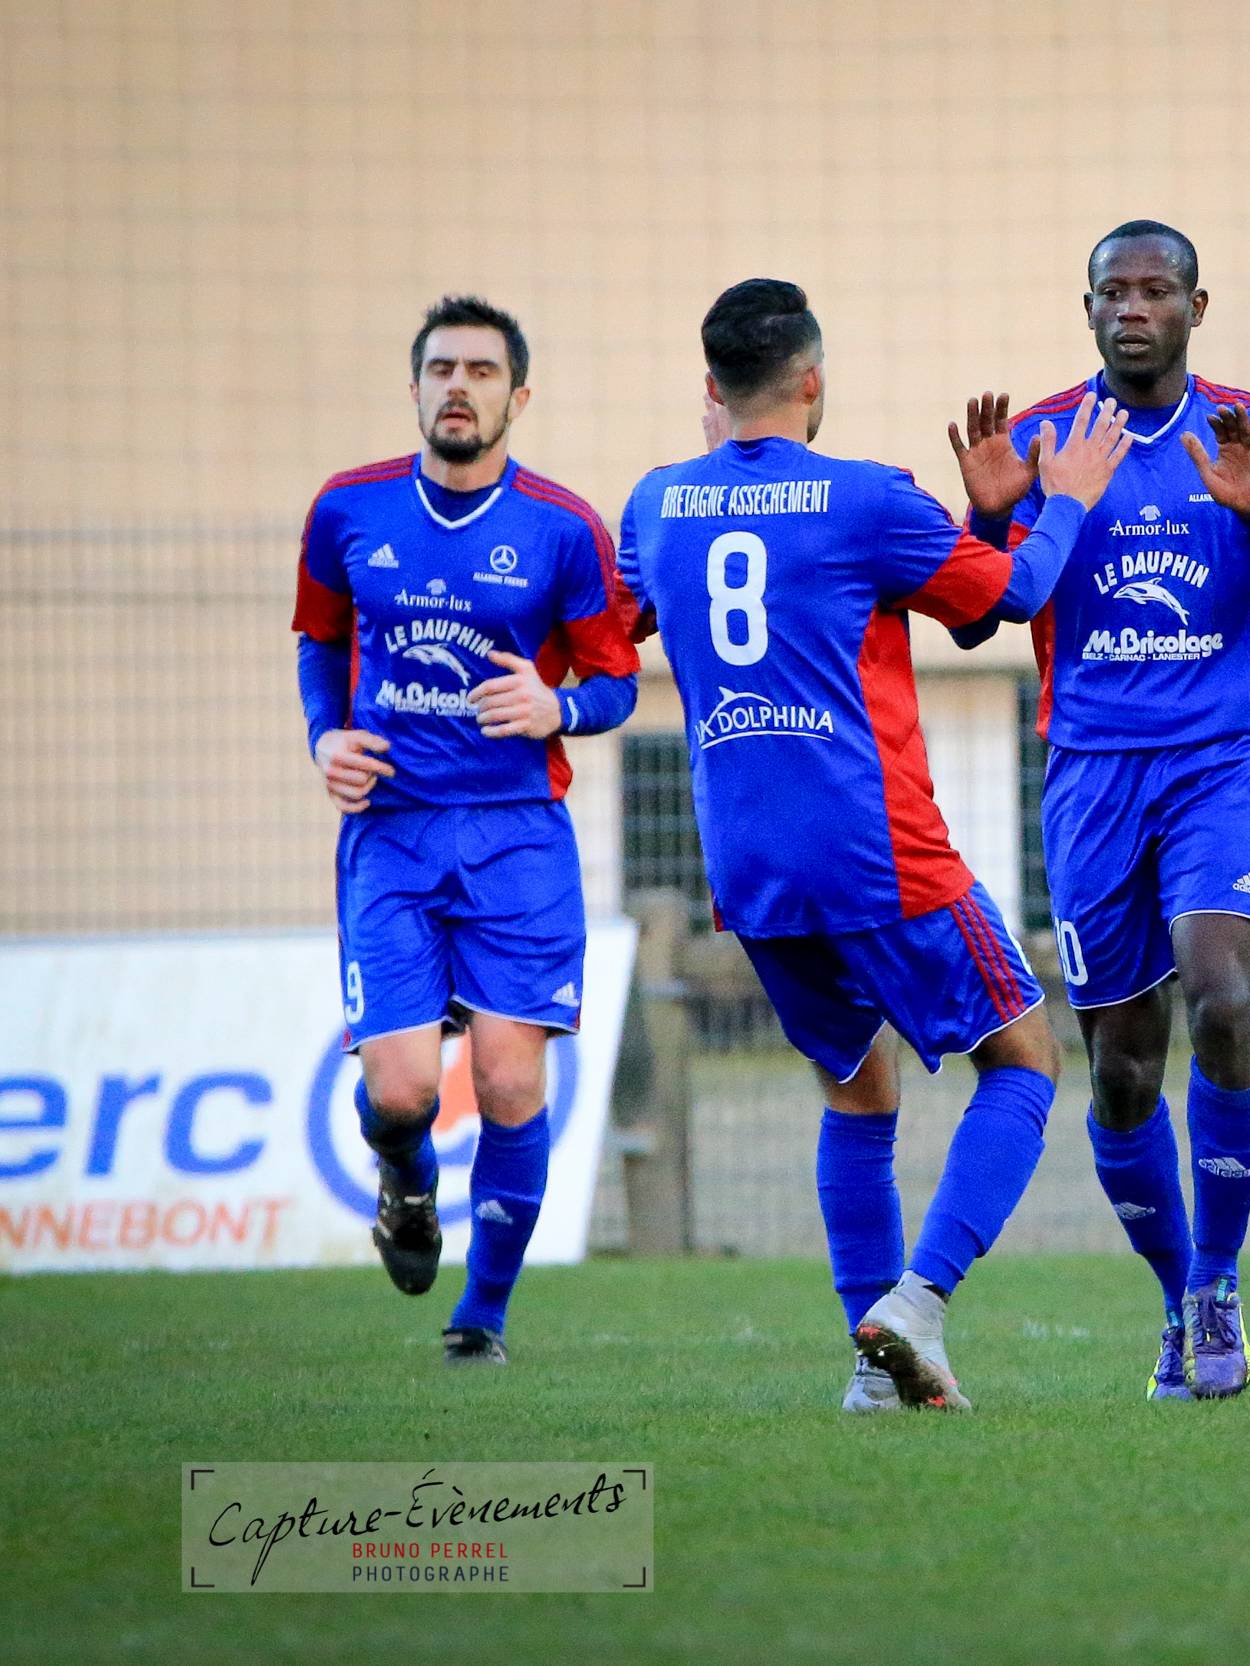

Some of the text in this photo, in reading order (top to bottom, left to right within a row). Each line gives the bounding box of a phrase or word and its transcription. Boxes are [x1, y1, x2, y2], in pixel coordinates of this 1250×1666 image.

[660, 480, 831, 518] BRETAGNE ASSECHEMENT
[1093, 551, 1210, 595] LE DAUPHIN
[706, 530, 769, 666] 8
[384, 619, 495, 658] LE DAUPHIN
[1109, 653, 1146, 662] CARNAC
[1152, 652, 1201, 661] LANESTER
[716, 706, 834, 734] DOLPHINA
[345, 961, 366, 1026] 9
[0, 1070, 274, 1178] erc
